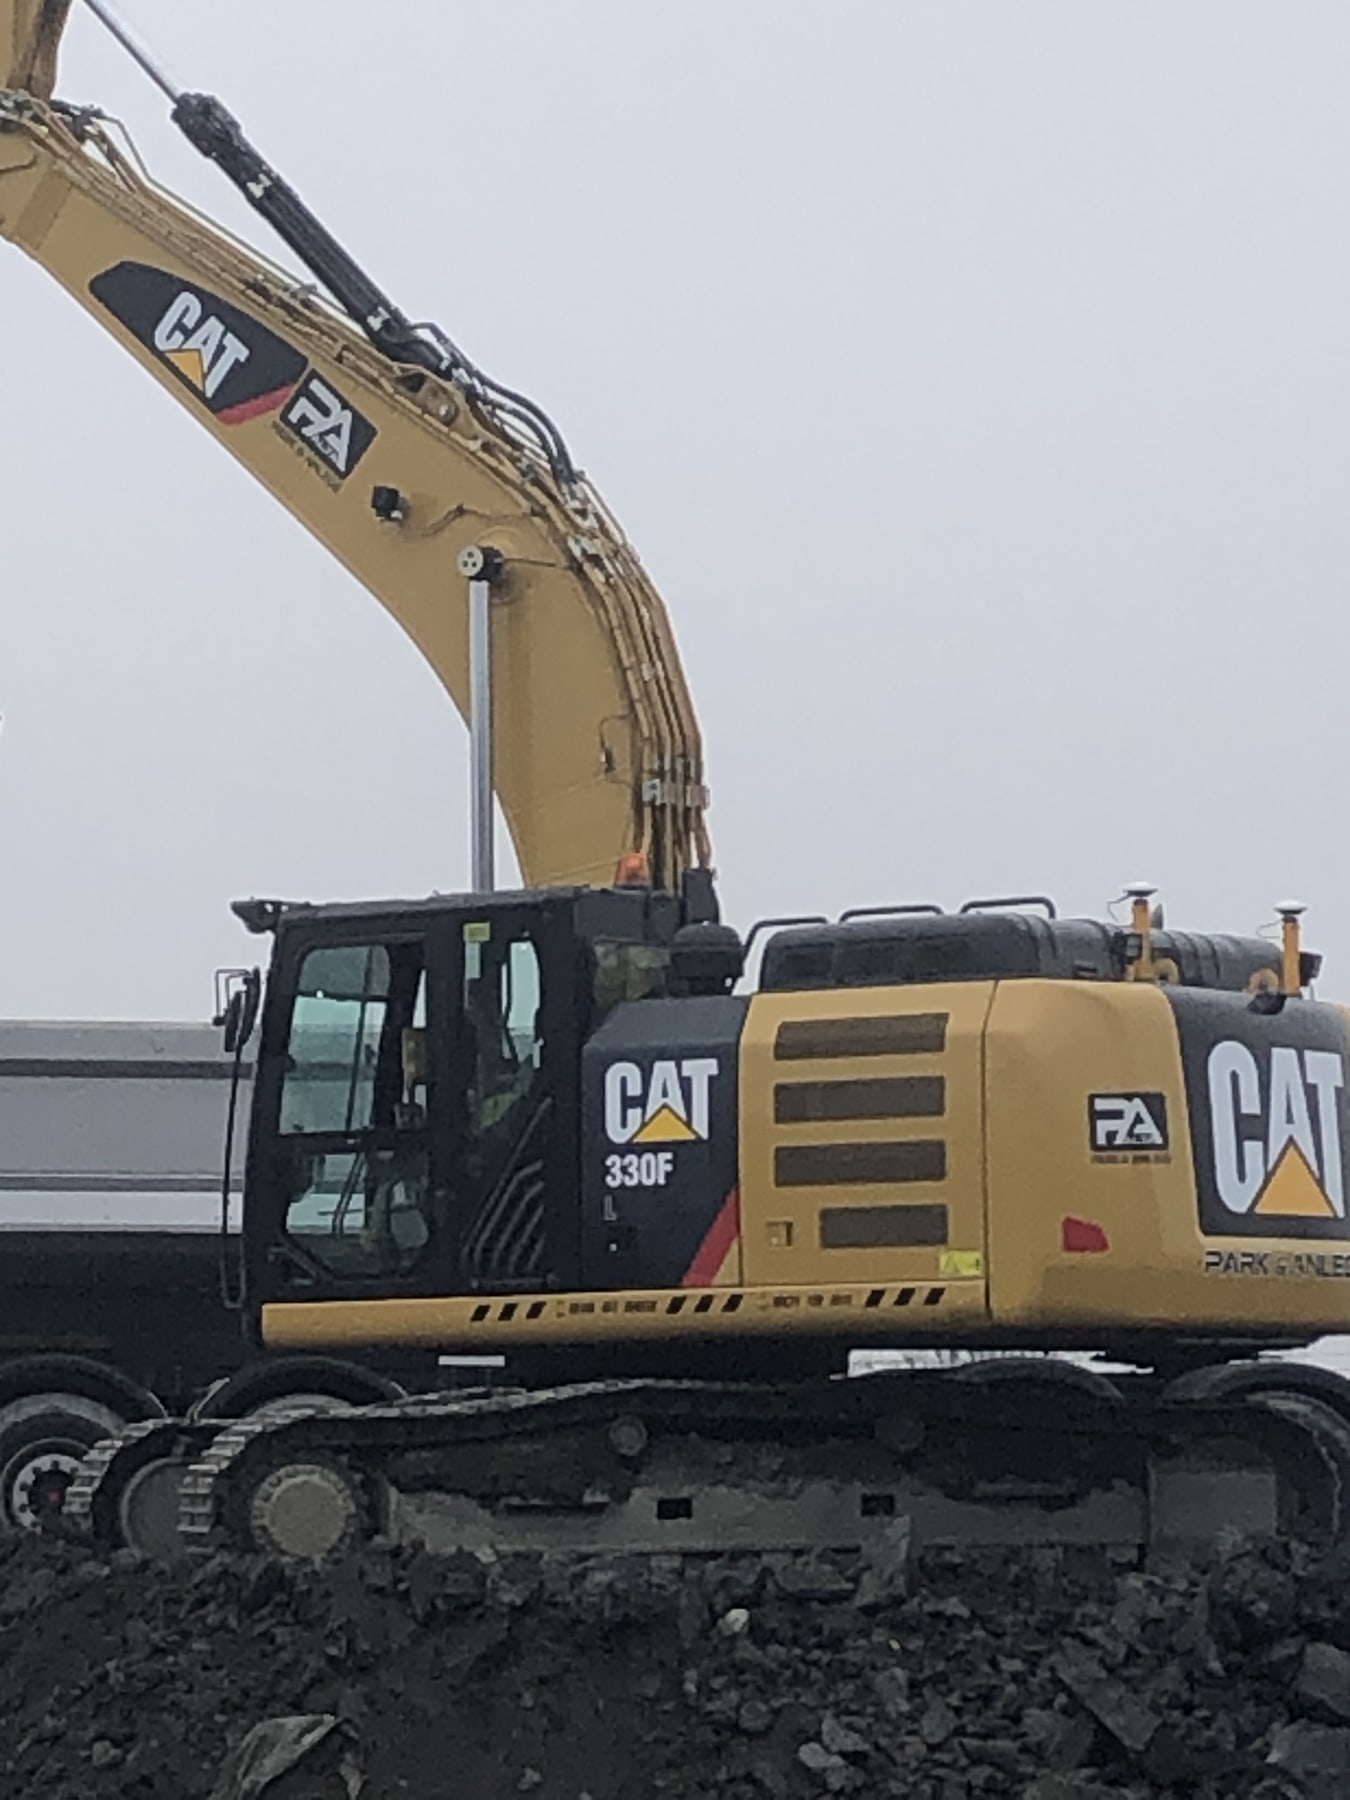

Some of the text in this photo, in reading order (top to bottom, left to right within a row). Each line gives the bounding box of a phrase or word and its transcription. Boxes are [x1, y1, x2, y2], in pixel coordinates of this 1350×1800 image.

[154, 291, 250, 399] CAT
[604, 1058, 719, 1145] CAT
[1207, 1040, 1345, 1218] CAT
[604, 1152, 674, 1188] 330F
[1205, 1250, 1269, 1275] PARK
